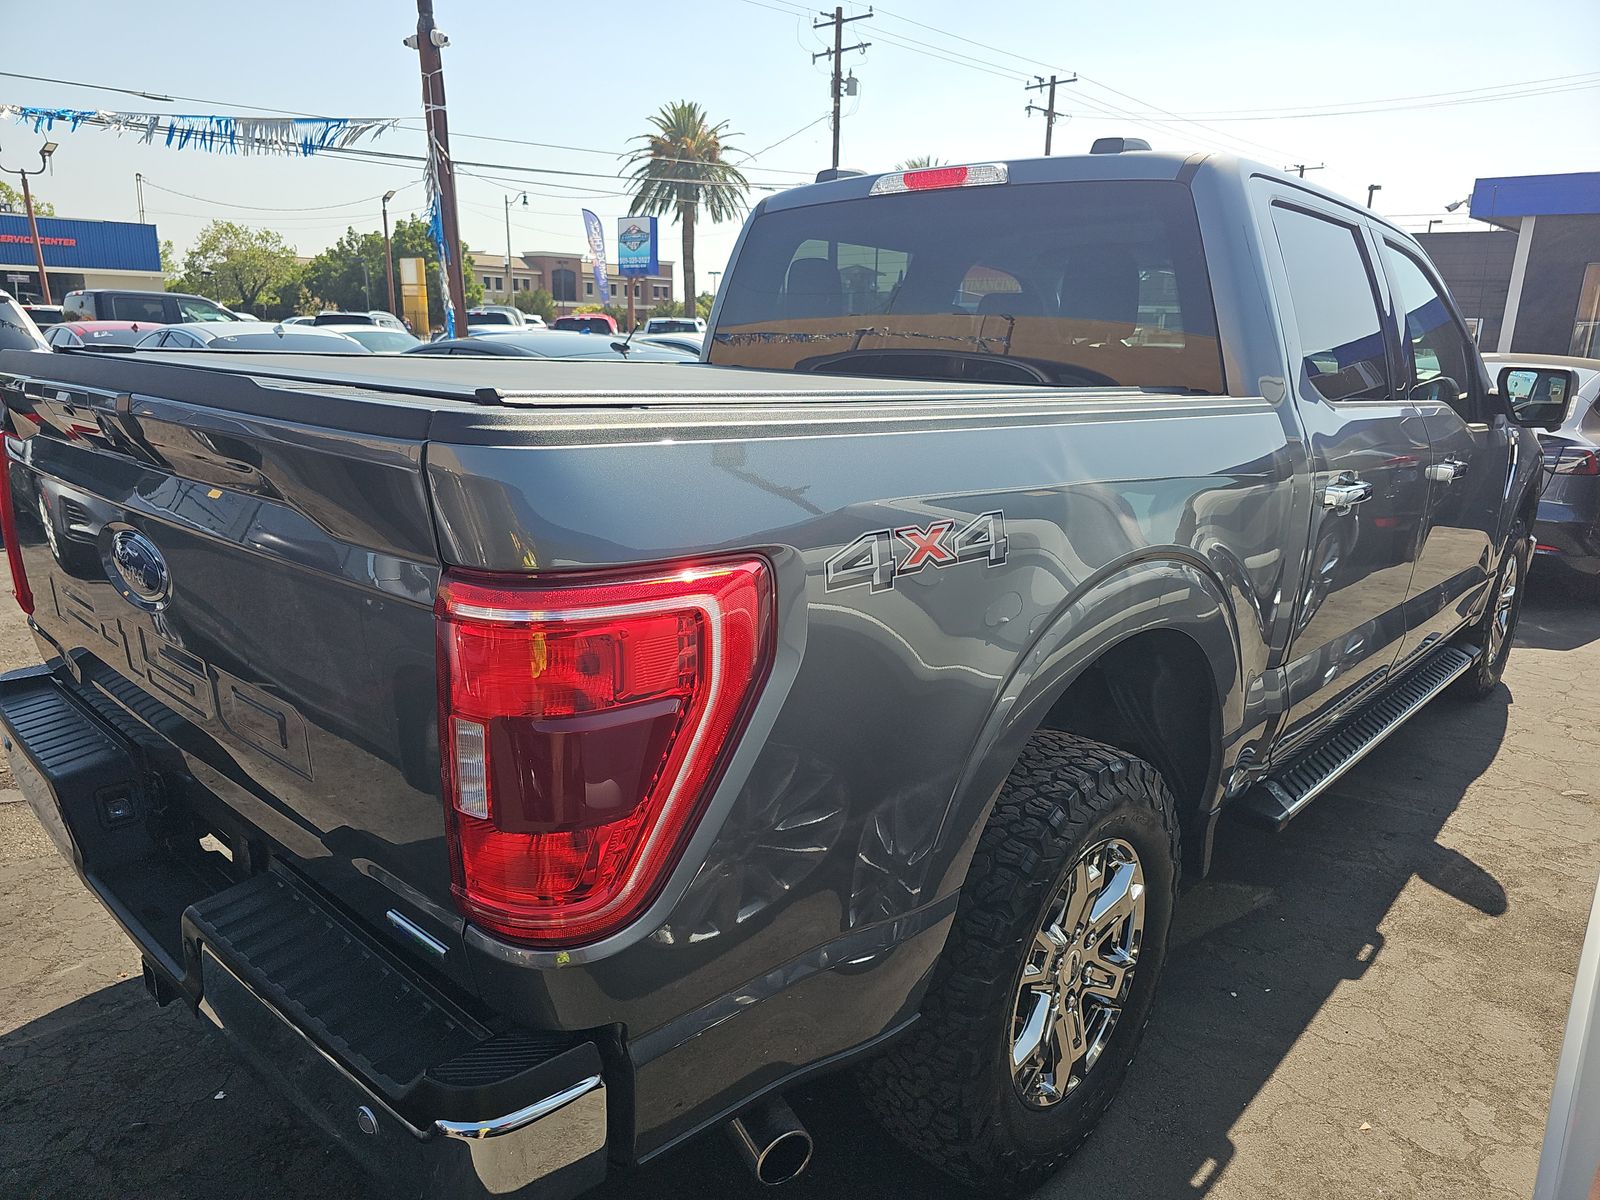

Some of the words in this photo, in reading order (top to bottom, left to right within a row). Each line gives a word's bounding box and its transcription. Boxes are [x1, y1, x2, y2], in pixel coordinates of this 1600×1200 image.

[39, 236, 76, 247] CENTER
[590, 220, 604, 251] CHECK
[117, 544, 151, 588] Ford
